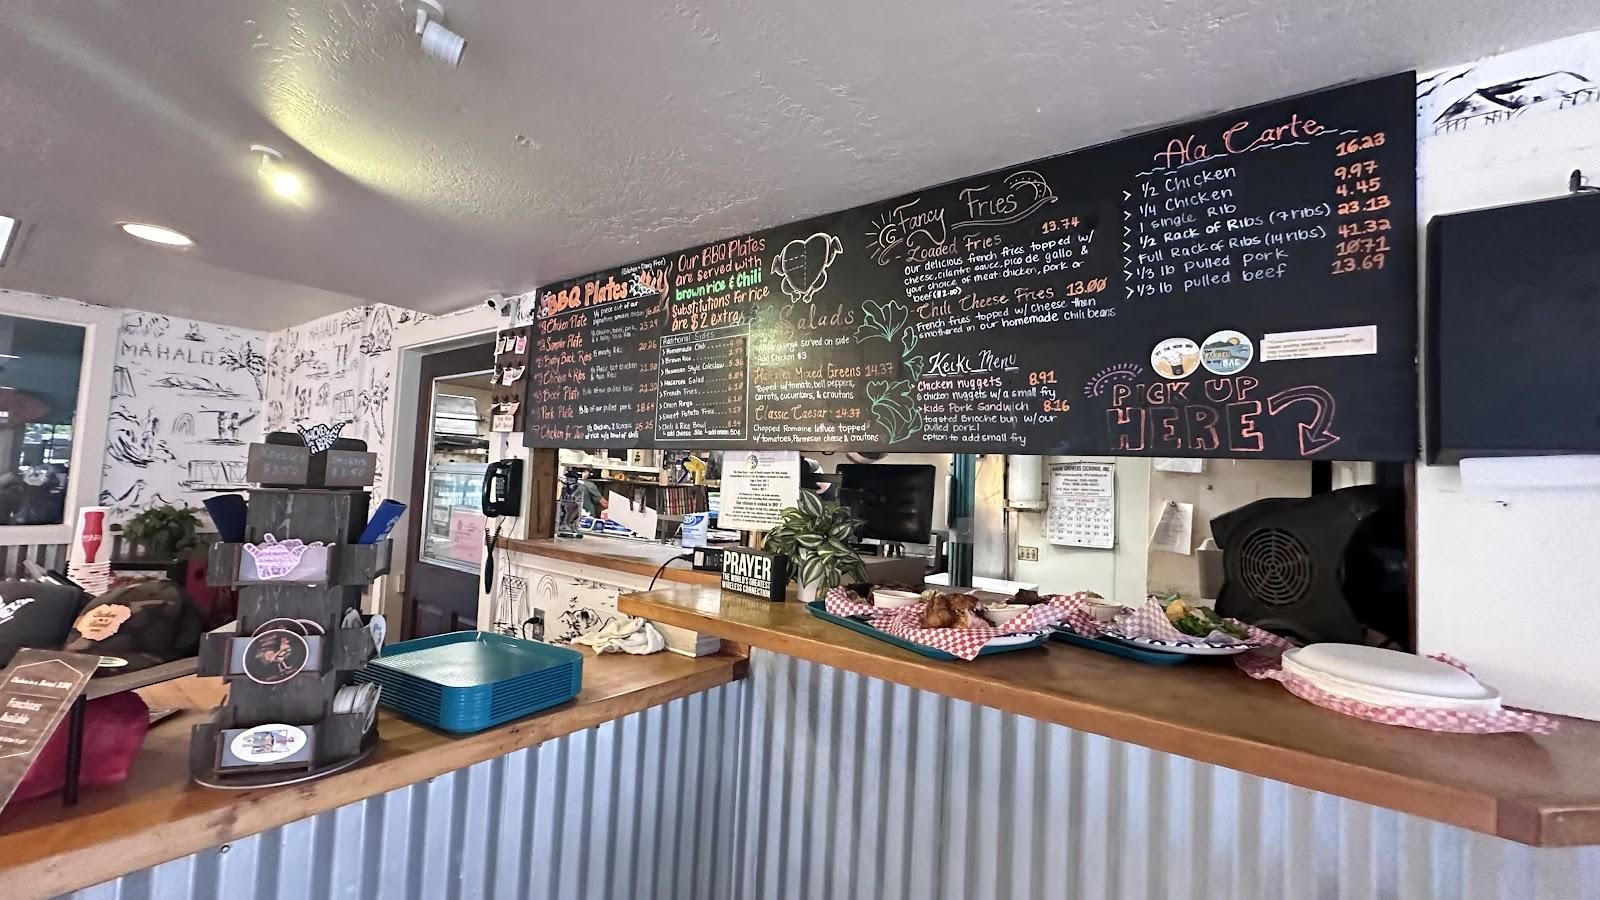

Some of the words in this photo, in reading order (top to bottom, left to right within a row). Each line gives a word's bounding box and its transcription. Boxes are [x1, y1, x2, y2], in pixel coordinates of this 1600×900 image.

[1154, 135, 1209, 168] Ala
[1223, 114, 1324, 153] Carte
[1166, 167, 1236, 192] Chicken
[1336, 134, 1385, 156] 16.23
[1166, 187, 1233, 211] Chicken
[1334, 161, 1377, 179] 9.97
[1207, 203, 1237, 217] Rib
[1336, 177, 1381, 197] 4.45
[893, 198, 946, 241] Fancy
[959, 185, 1017, 218] Fries
[1164, 228, 1200, 242] Rack
[1206, 220, 1222, 234] of
[1227, 214, 1263, 231] Ribs
[1338, 195, 1391, 215] 23.13
[679, 255, 699, 271] Our
[702, 244, 725, 266] BBQ
[728, 236, 765, 258] Plates
[905, 264, 921, 275] Our
[924, 256, 963, 271] delicious
[968, 252, 997, 263] french
[1001, 245, 1025, 257] fries
[1030, 236, 1071, 253] topped
[1078, 231, 1095, 243] w/
[906, 237, 957, 262] Loaded
[963, 232, 1001, 251] Fries
[1042, 217, 1079, 234] 13.74
[1138, 250, 1164, 264] Full
[1229, 235, 1261, 249] Ribs
[1338, 219, 1391, 237] 41.32
[676, 274, 693, 286] are
[697, 260, 732, 281] served
[735, 255, 761, 271] with
[1045, 249, 1072, 268] gallo
[1080, 246, 1088, 255] &
[1160, 261, 1175, 275] lb
[1184, 255, 1231, 272] pulled
[1243, 249, 1288, 268] pork
[676, 285, 705, 300] brown
[706, 280, 726, 294] rice
[737, 268, 761, 287] Chili
[905, 284, 924, 297] your
[927, 279, 957, 291] choice
[961, 275, 971, 285] of
[1043, 261, 1068, 276] pork
[1072, 261, 1084, 270] or
[1160, 282, 1173, 294] lb
[1184, 273, 1231, 292] pulled
[1242, 263, 1287, 282] beef
[1331, 255, 1385, 275] 13.69
[548, 286, 581, 315] BBQ
[585, 276, 627, 306] Plates
[672, 294, 730, 318] Substitutions
[749, 286, 769, 302] rice
[917, 301, 951, 320] Chili
[959, 294, 1008, 311] Cheese
[1015, 288, 1054, 300] Fries
[672, 318, 688, 331] are
[711, 310, 738, 325] extra
[780, 304, 854, 340] Salads
[919, 327, 963, 339] smothered
[980, 321, 998, 330] our
[1001, 312, 1059, 328] homemade
[1087, 308, 1116, 318] beans
[949, 315, 970, 326] fries
[975, 308, 1009, 322] topped
[1071, 298, 1096, 308] then
[121, 341, 214, 366] MAHALO
[801, 337, 822, 347] served
[835, 336, 849, 345] side
[827, 363, 861, 377] Greens
[865, 363, 894, 377] 14.37
[979, 350, 1017, 371] Menu
[918, 381, 953, 392] Chicken
[958, 377, 1002, 390] nuggets
[952, 390, 987, 401] nuggets
[1012, 387, 1036, 397] small
[1040, 386, 1056, 400] fry
[1113, 382, 1190, 405] PICK
[1205, 377, 1258, 402] UP
[755, 405, 789, 421] Classic
[791, 404, 827, 418] Caesar
[949, 402, 973, 411] Pork
[977, 401, 1028, 411] Sandwich
[1043, 401, 1070, 412] 8.16
[961, 415, 996, 423] Brioche
[1000, 414, 1017, 423] bun
[754, 424, 780, 433] Chopped
[924, 424, 948, 432] pulled
[962, 434, 980, 442] add
[1010, 434, 1026, 447] fry
[1107, 400, 1263, 451] HERE
[723, 551, 771, 581] PRAYER
